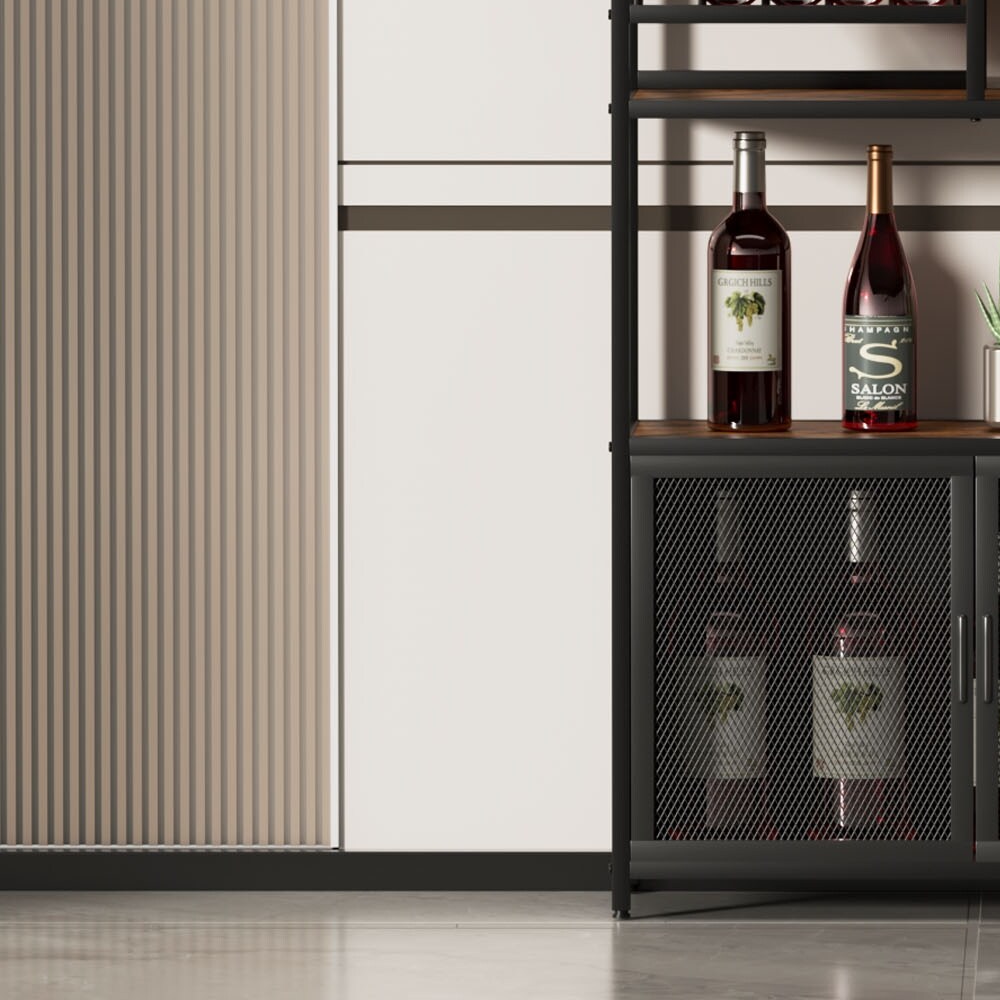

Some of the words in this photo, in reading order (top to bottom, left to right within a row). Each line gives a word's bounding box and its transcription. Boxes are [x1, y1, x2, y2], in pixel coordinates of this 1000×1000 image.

[750, 277, 773, 287] HILLS
[848, 339, 903, 379] S
[851, 383, 907, 395] SALON
